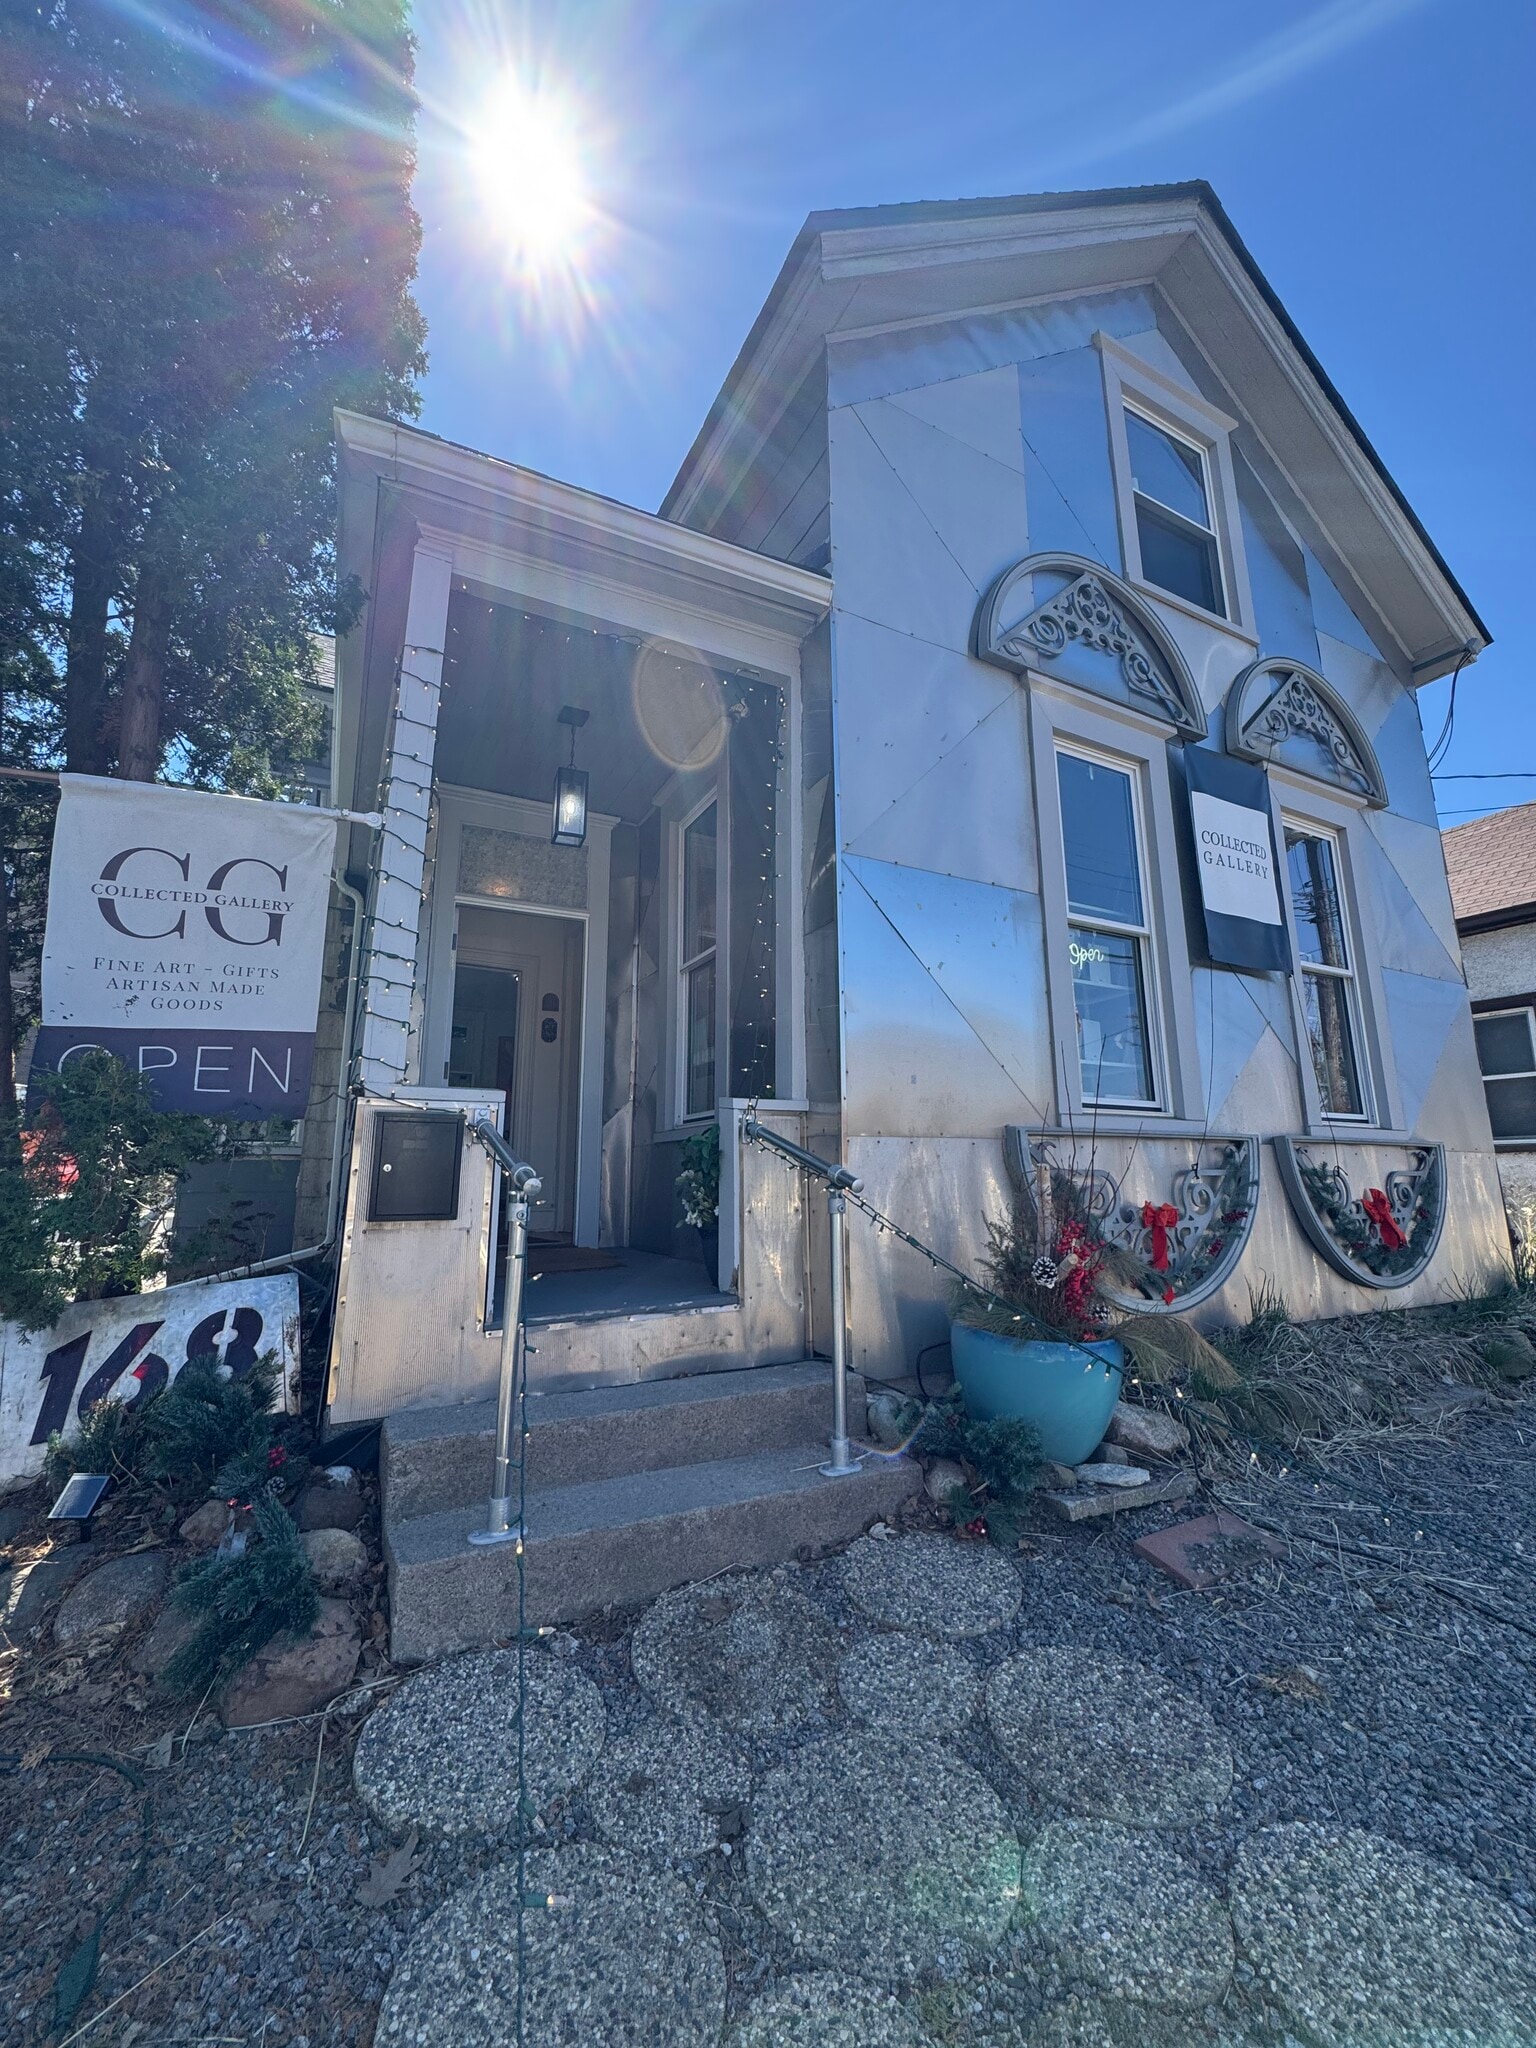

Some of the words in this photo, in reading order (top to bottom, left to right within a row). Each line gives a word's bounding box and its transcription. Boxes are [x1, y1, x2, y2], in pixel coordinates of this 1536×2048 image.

[1201, 830, 1267, 860] COLLECTED
[1203, 851, 1268, 879] GALLERY
[91, 882, 208, 904] COLLECTED
[214, 894, 296, 913] GALLERY
[97, 847, 289, 947] CG
[93, 957, 145, 973] FINE
[154, 960, 196, 975] ART
[223, 963, 281, 980] GIFTS
[106, 976, 201, 993] ARTISAN
[209, 981, 266, 996] MADE
[150, 996, 224, 1011] GOODS
